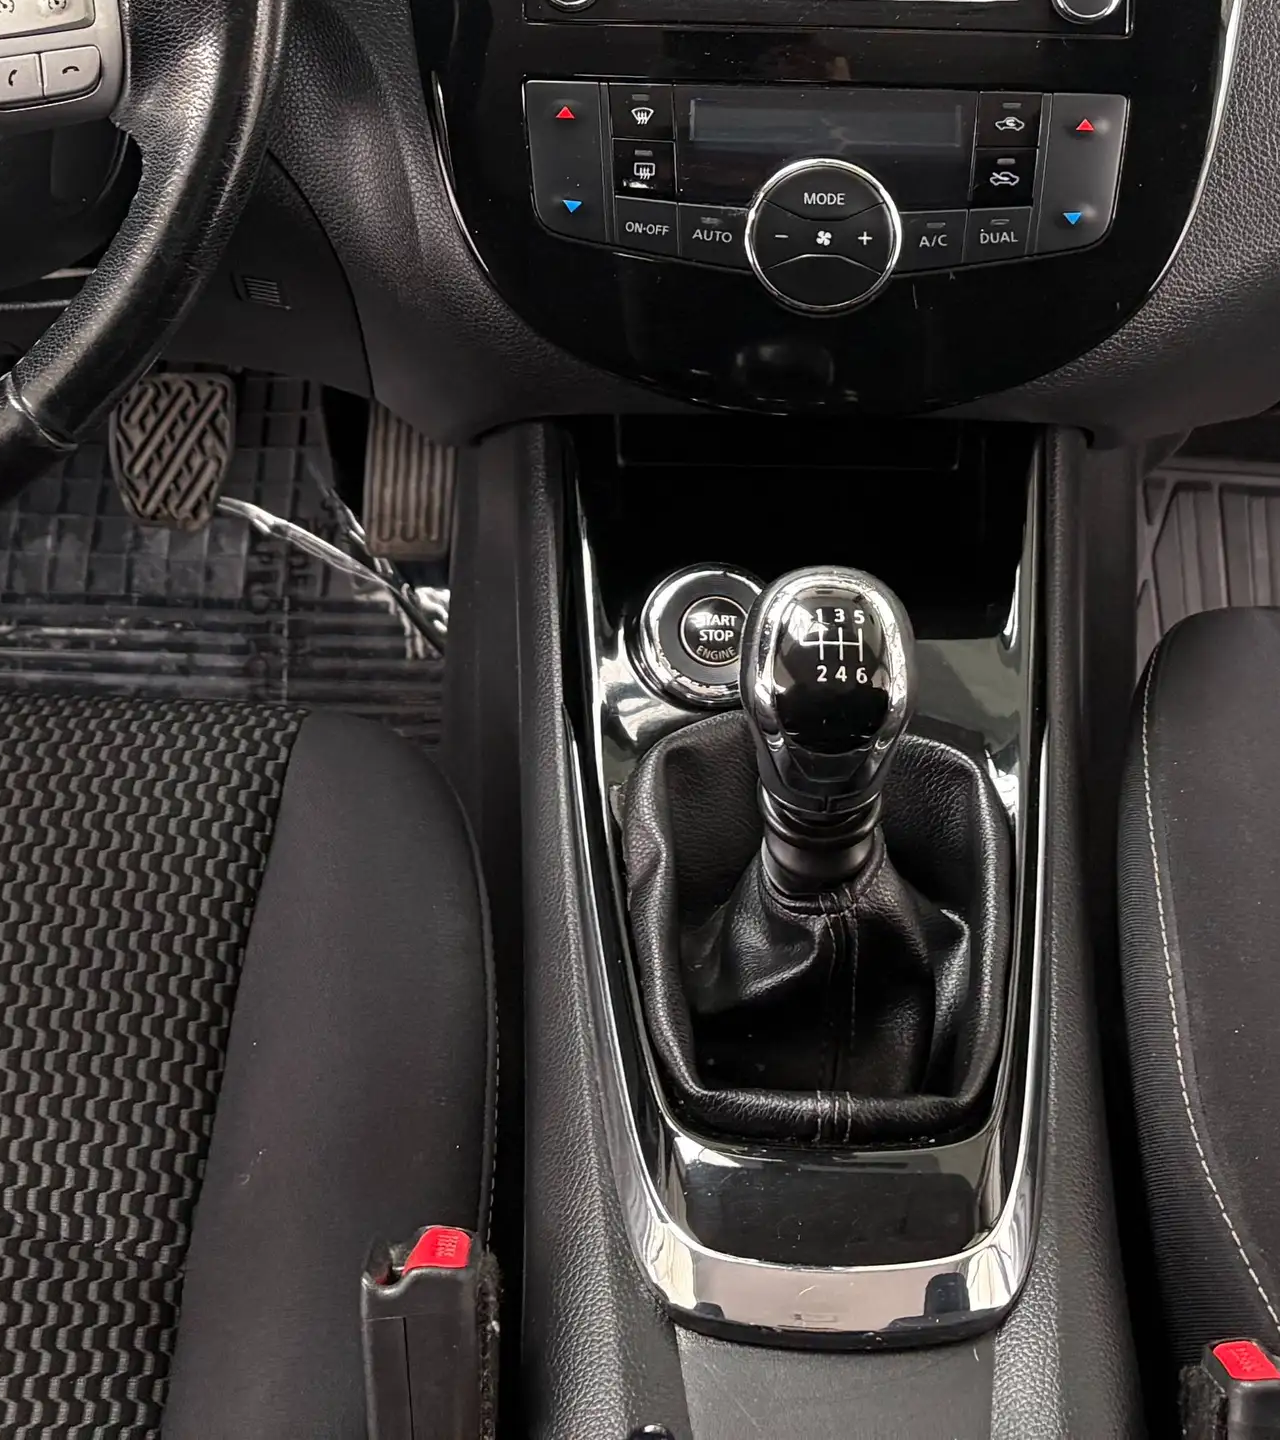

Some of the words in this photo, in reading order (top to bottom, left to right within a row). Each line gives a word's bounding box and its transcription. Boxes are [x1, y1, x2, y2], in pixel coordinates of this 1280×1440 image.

[803, 191, 846, 206] MODE
[692, 229, 733, 244] AUTO
[919, 233, 948, 248] A/C
[979, 231, 1019, 245] DUAL
[693, 615, 738, 628] START
[833, 608, 845, 622] 3
[853, 610, 865, 624] 5
[699, 629, 735, 642] STOP
[695, 644, 737, 661] ENGINE
[816, 665, 828, 682] 2
[834, 665, 848, 682] 4
[855, 667, 869, 684] 6
